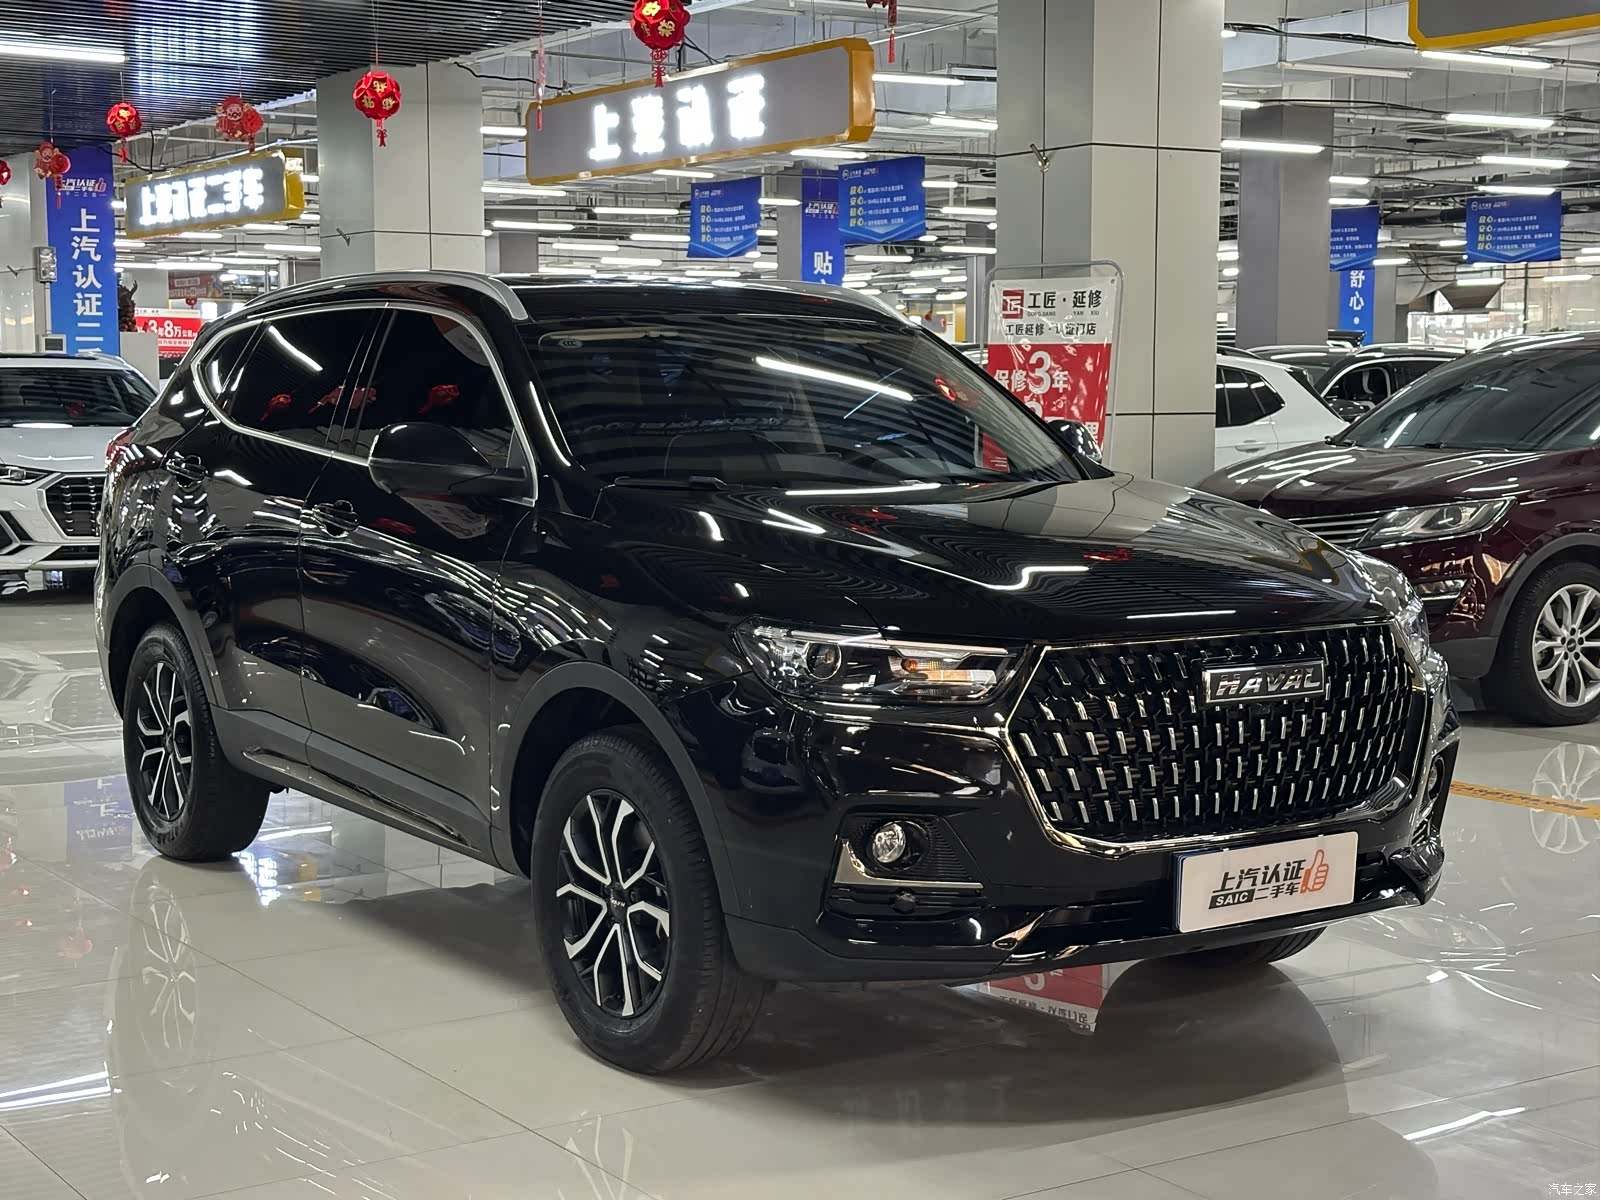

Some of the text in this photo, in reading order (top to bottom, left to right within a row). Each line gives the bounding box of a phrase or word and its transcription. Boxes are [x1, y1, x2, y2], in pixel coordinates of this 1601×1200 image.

[70, 208, 103, 353] 上汽认证二
[813, 251, 833, 285] 贴
[1215, 667, 1321, 696] HAVAL
[1212, 858, 1306, 893] 上汽认证
[1214, 890, 1250, 907] SAIC
[1254, 882, 1300, 901] 二手车
